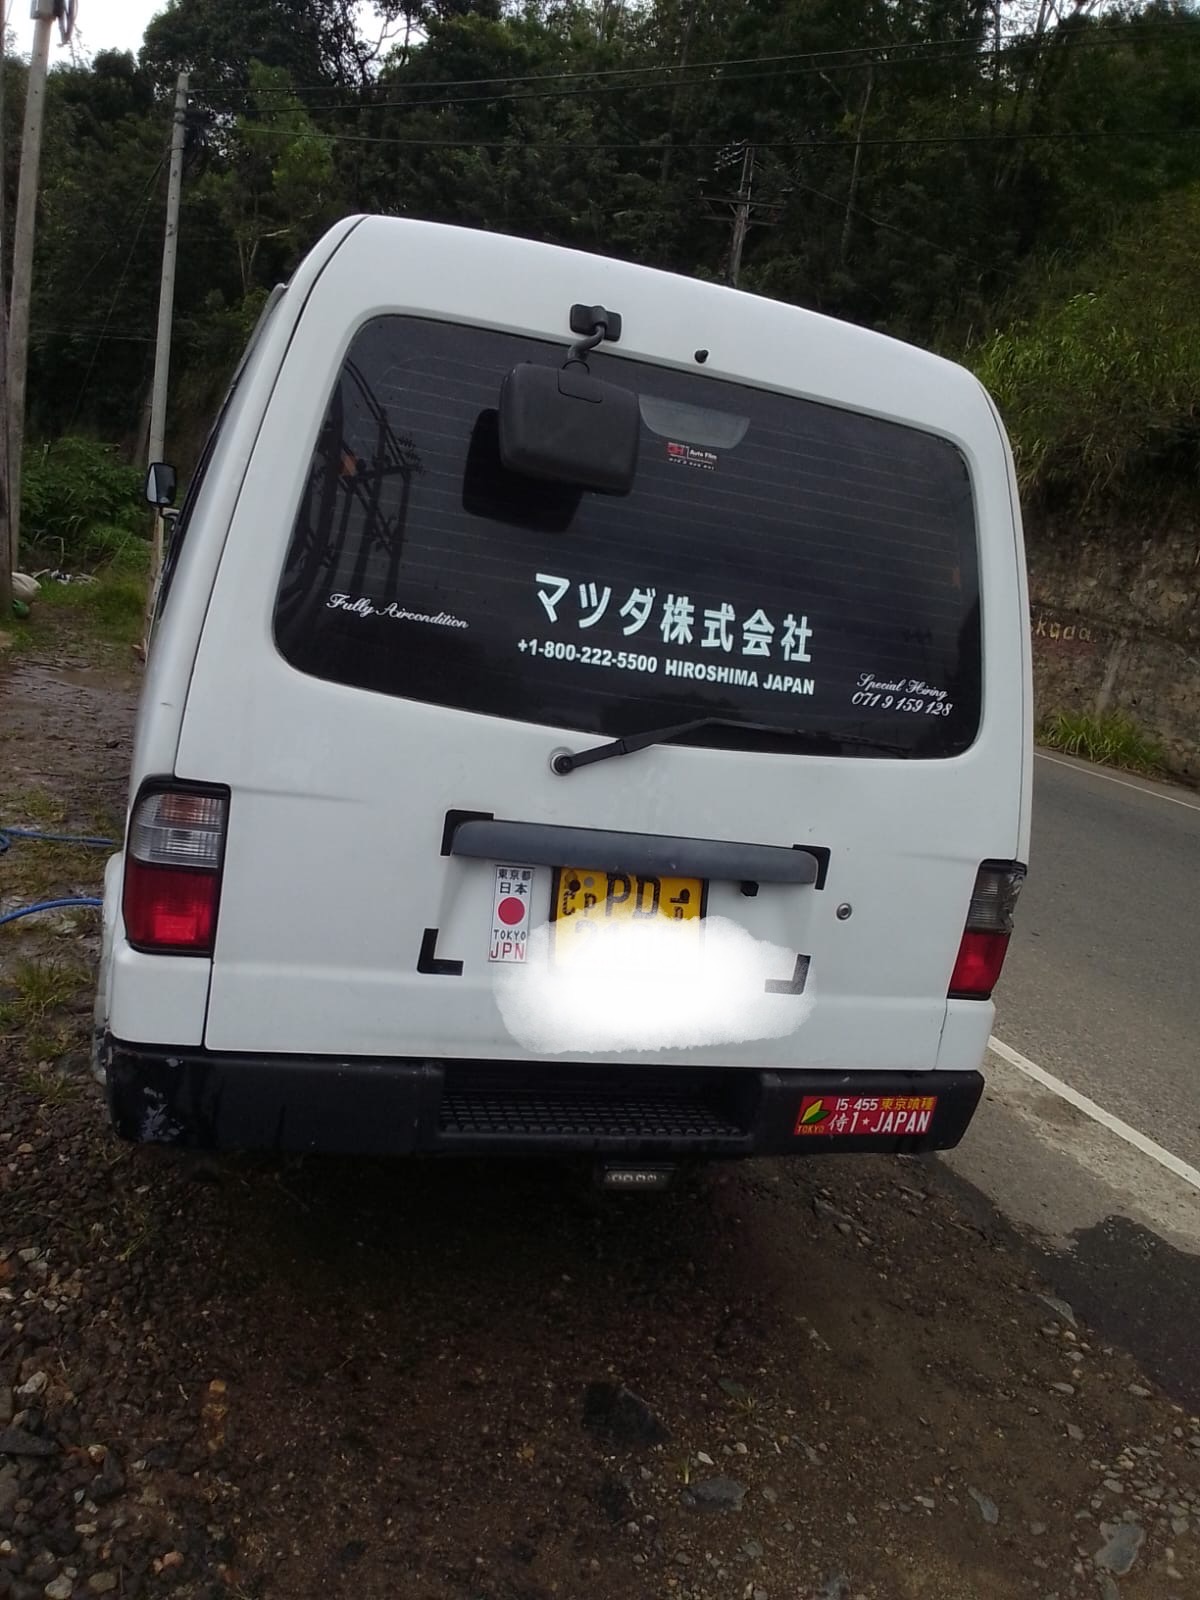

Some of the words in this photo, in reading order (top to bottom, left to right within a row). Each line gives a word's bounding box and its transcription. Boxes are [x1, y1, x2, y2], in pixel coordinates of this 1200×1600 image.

[326, 593, 374, 618] Fully
[375, 602, 469, 629] Aircondition
[535, 573, 813, 663] マツダ株式会社
[517, 638, 658, 673] +1-800-222-5500
[664, 659, 759, 688] HIROSHIMA
[762, 673, 816, 696] JAPAN
[856, 672, 906, 691] Special
[905, 679, 948, 701] Hiring
[851, 691, 882, 708] 071
[895, 697, 924, 713] 159
[924, 701, 954, 717] 128
[497, 868, 531, 881] 東京都
[499, 881, 528, 895] 日本
[493, 928, 527, 941] TOKYO
[490, 942, 525, 960] JPN
[797, 1124, 825, 1134] TOKYO
[870, 1111, 931, 1133] JAPAN
